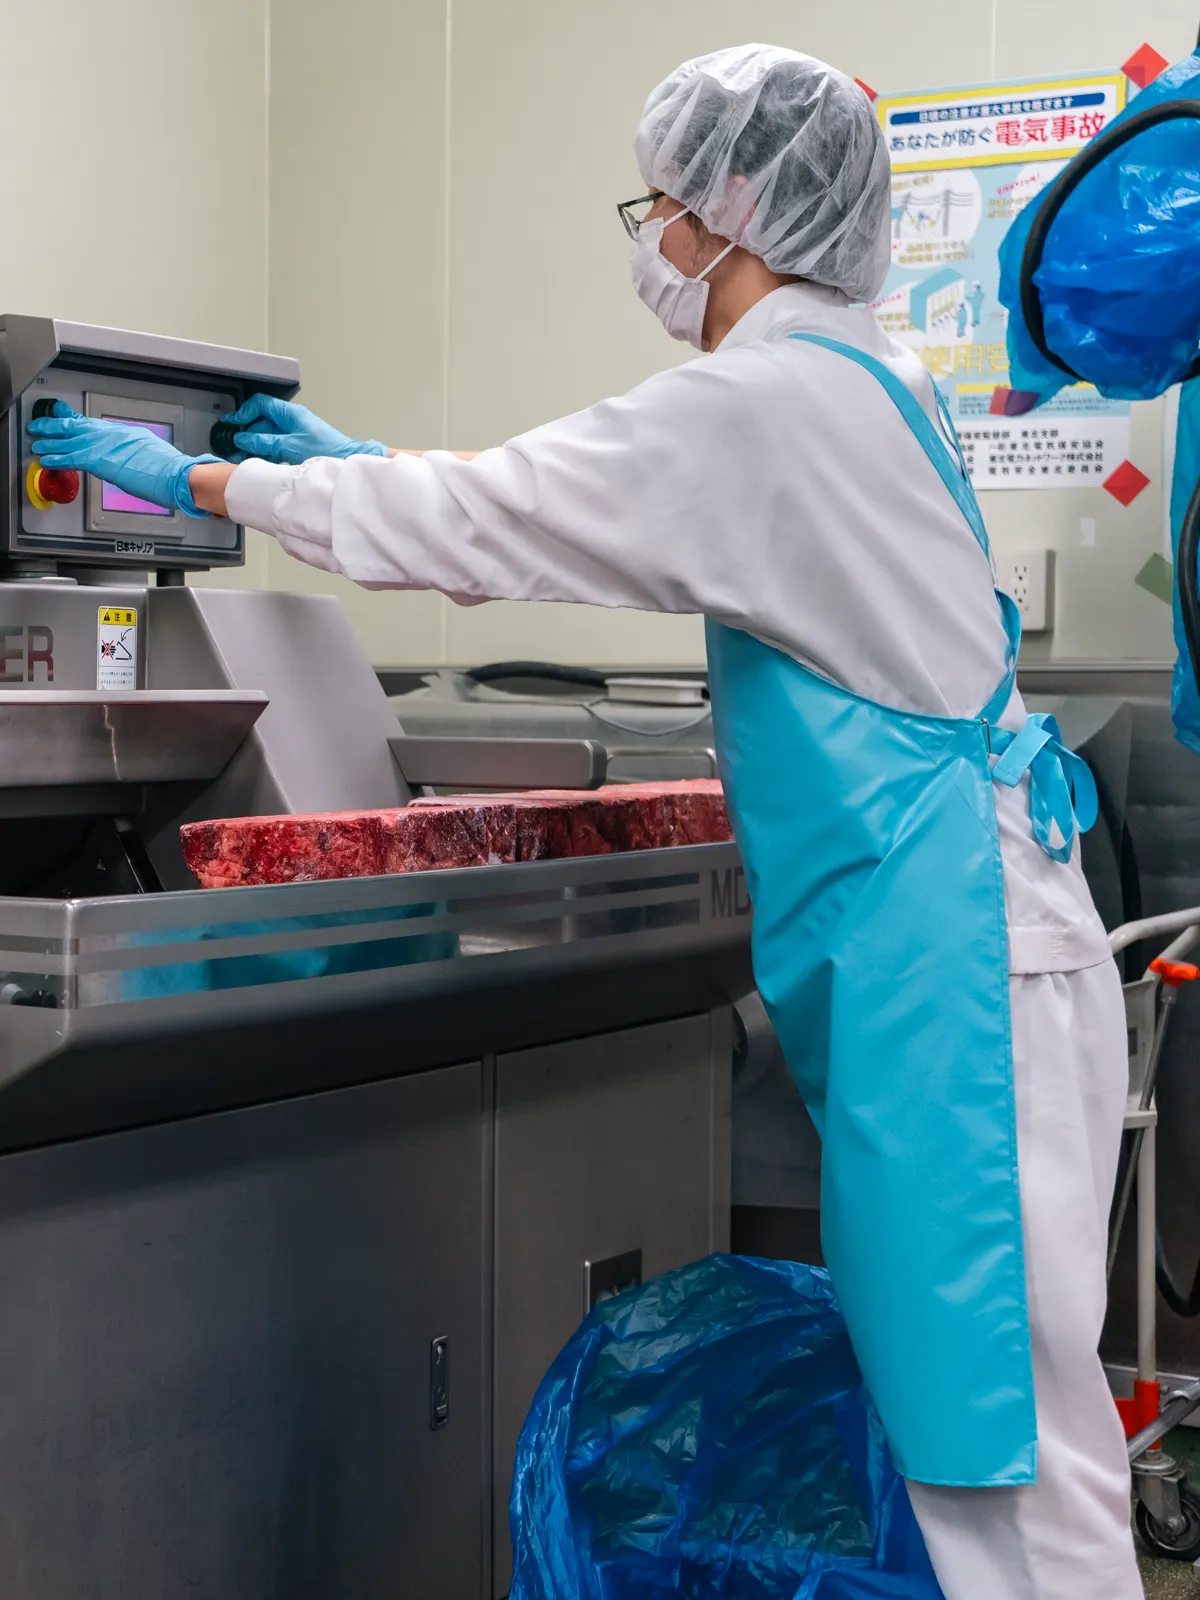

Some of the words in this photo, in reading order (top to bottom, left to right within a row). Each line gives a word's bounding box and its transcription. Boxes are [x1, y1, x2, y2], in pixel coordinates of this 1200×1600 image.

[911, 343, 1010, 376] 使用安
[117, 541, 152, 553] 日本キャリア
[114, 613, 132, 622] 注意
